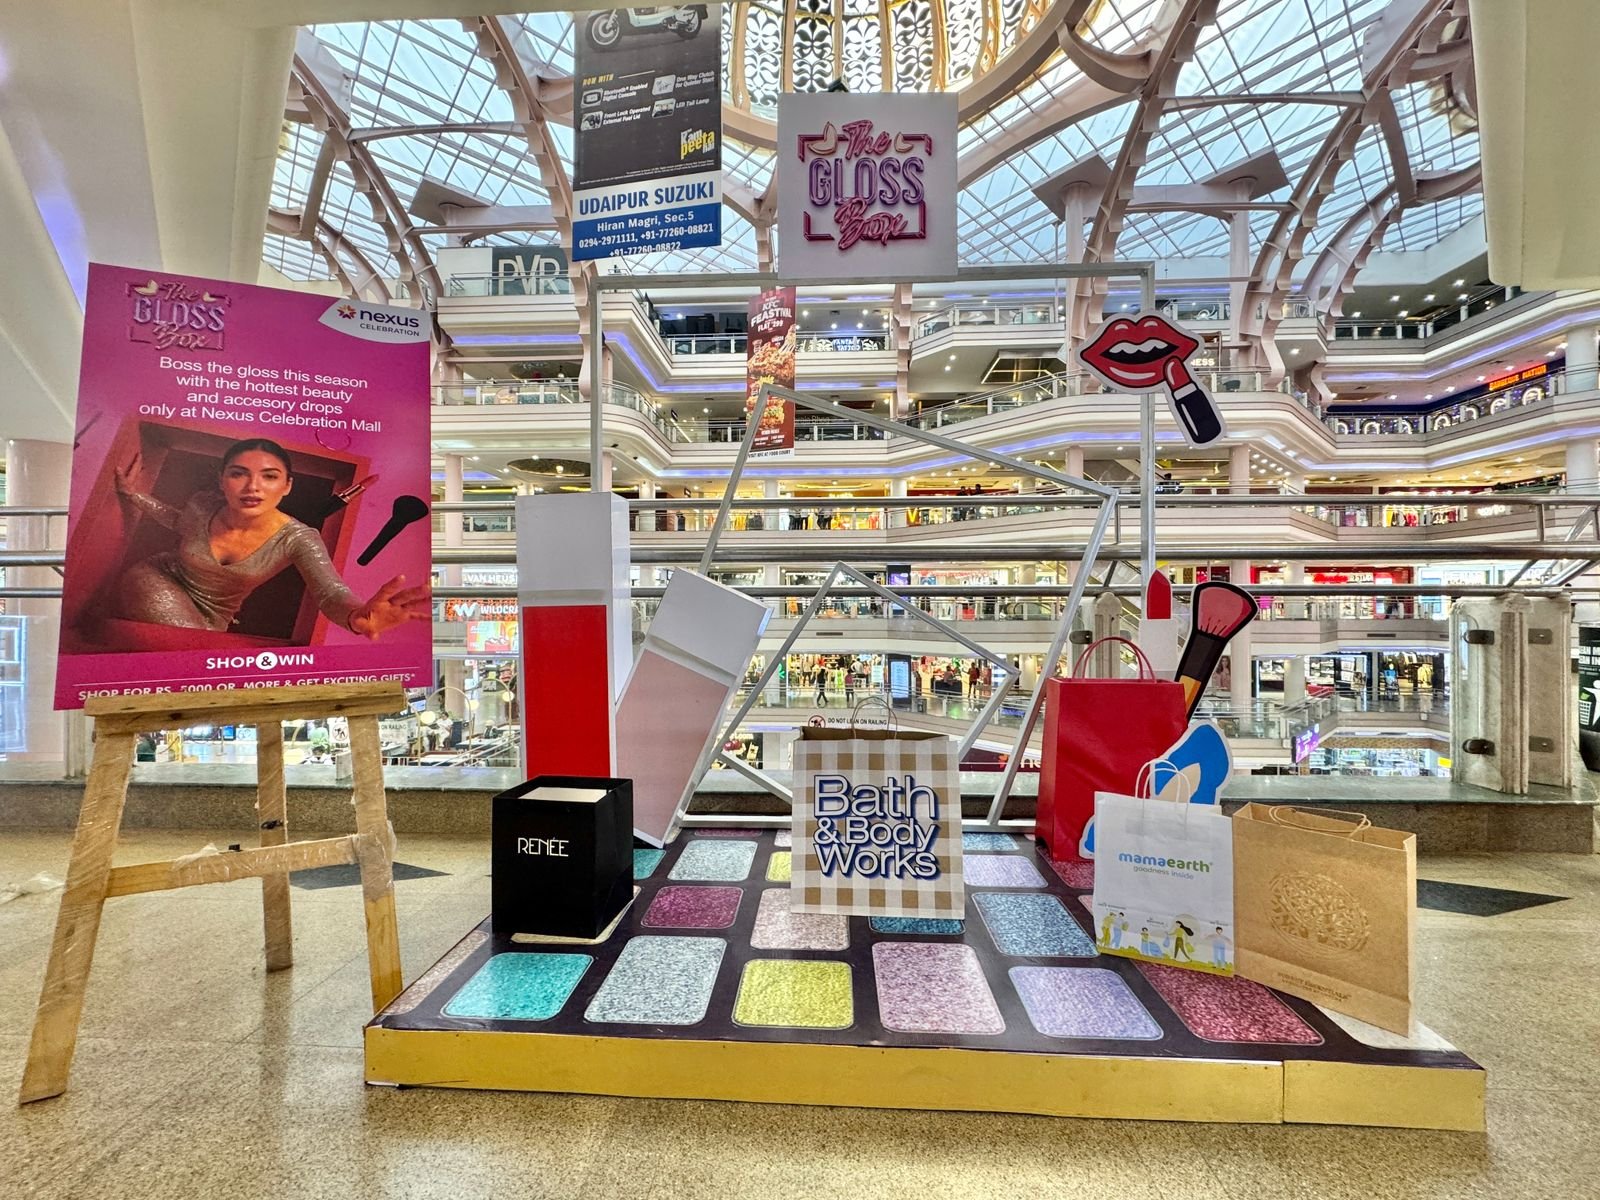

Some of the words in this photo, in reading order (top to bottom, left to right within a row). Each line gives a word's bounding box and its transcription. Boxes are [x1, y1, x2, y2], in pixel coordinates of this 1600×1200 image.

[598, 74, 614, 82] WITH
[629, 106, 651, 116] Operated
[681, 129, 702, 145] Kam
[681, 130, 715, 160] peeta
[842, 119, 892, 160] The
[808, 156, 925, 206] GLOSS
[580, 190, 648, 215] UDAIPUR
[655, 181, 713, 205] SUZUKI
[597, 220, 625, 232] Hiran
[628, 216, 660, 228] Magri,
[665, 211, 694, 223] Sec.5
[834, 197, 908, 250] Box
[579, 233, 638, 248] 0294-2971111,
[641, 223, 713, 240] +91-77260-08821
[609, 241, 680, 257] +91-77260-08822
[498, 254, 560, 295] PVR
[162, 282, 199, 301] The
[134, 297, 225, 332] GLOSS
[751, 308, 792, 328] FEASTIVAL
[762, 300, 779, 311] KFC
[360, 310, 419, 328] nexus
[360, 323, 420, 336] CELEBRATION
[758, 323, 771, 332] FLAT
[152, 321, 210, 352] Box
[160, 356, 202, 372] Boss
[207, 362, 232, 375] the
[237, 365, 278, 379] gloss
[284, 369, 309, 382] this
[314, 374, 368, 389] season
[176, 374, 209, 387] with
[215, 378, 240, 390] the
[245, 380, 298, 396] hottest
[302, 385, 352, 404] beauty
[187, 391, 218, 404] and
[224, 395, 295, 413] accesory
[300, 400, 343, 416] drops
[139, 404, 176, 419] only
[181, 405, 196, 418] at
[202, 406, 254, 422] Nexus
[259, 411, 346, 430] Celebration
[352, 419, 381, 432] Mall
[488, 574, 517, 583] HEUS
[206, 656, 255, 670] SHOP
[279, 654, 314, 665] WIN
[78, 689, 119, 700] SHOP
[124, 687, 151, 696] FOR
[180, 684, 212, 693] 5000
[216, 683, 235, 691] OR
[323, 675, 376, 684] EXCITING
[814, 775, 938, 819] Bath
[518, 837, 569, 856] RENÉE
[813, 816, 846, 845] &
[845, 816, 938, 852] Body
[813, 842, 939, 879] Works
[1119, 853, 1210, 872] mamaearth
[1133, 866, 1170, 876] goodness
[1172, 871, 1194, 880] inside
